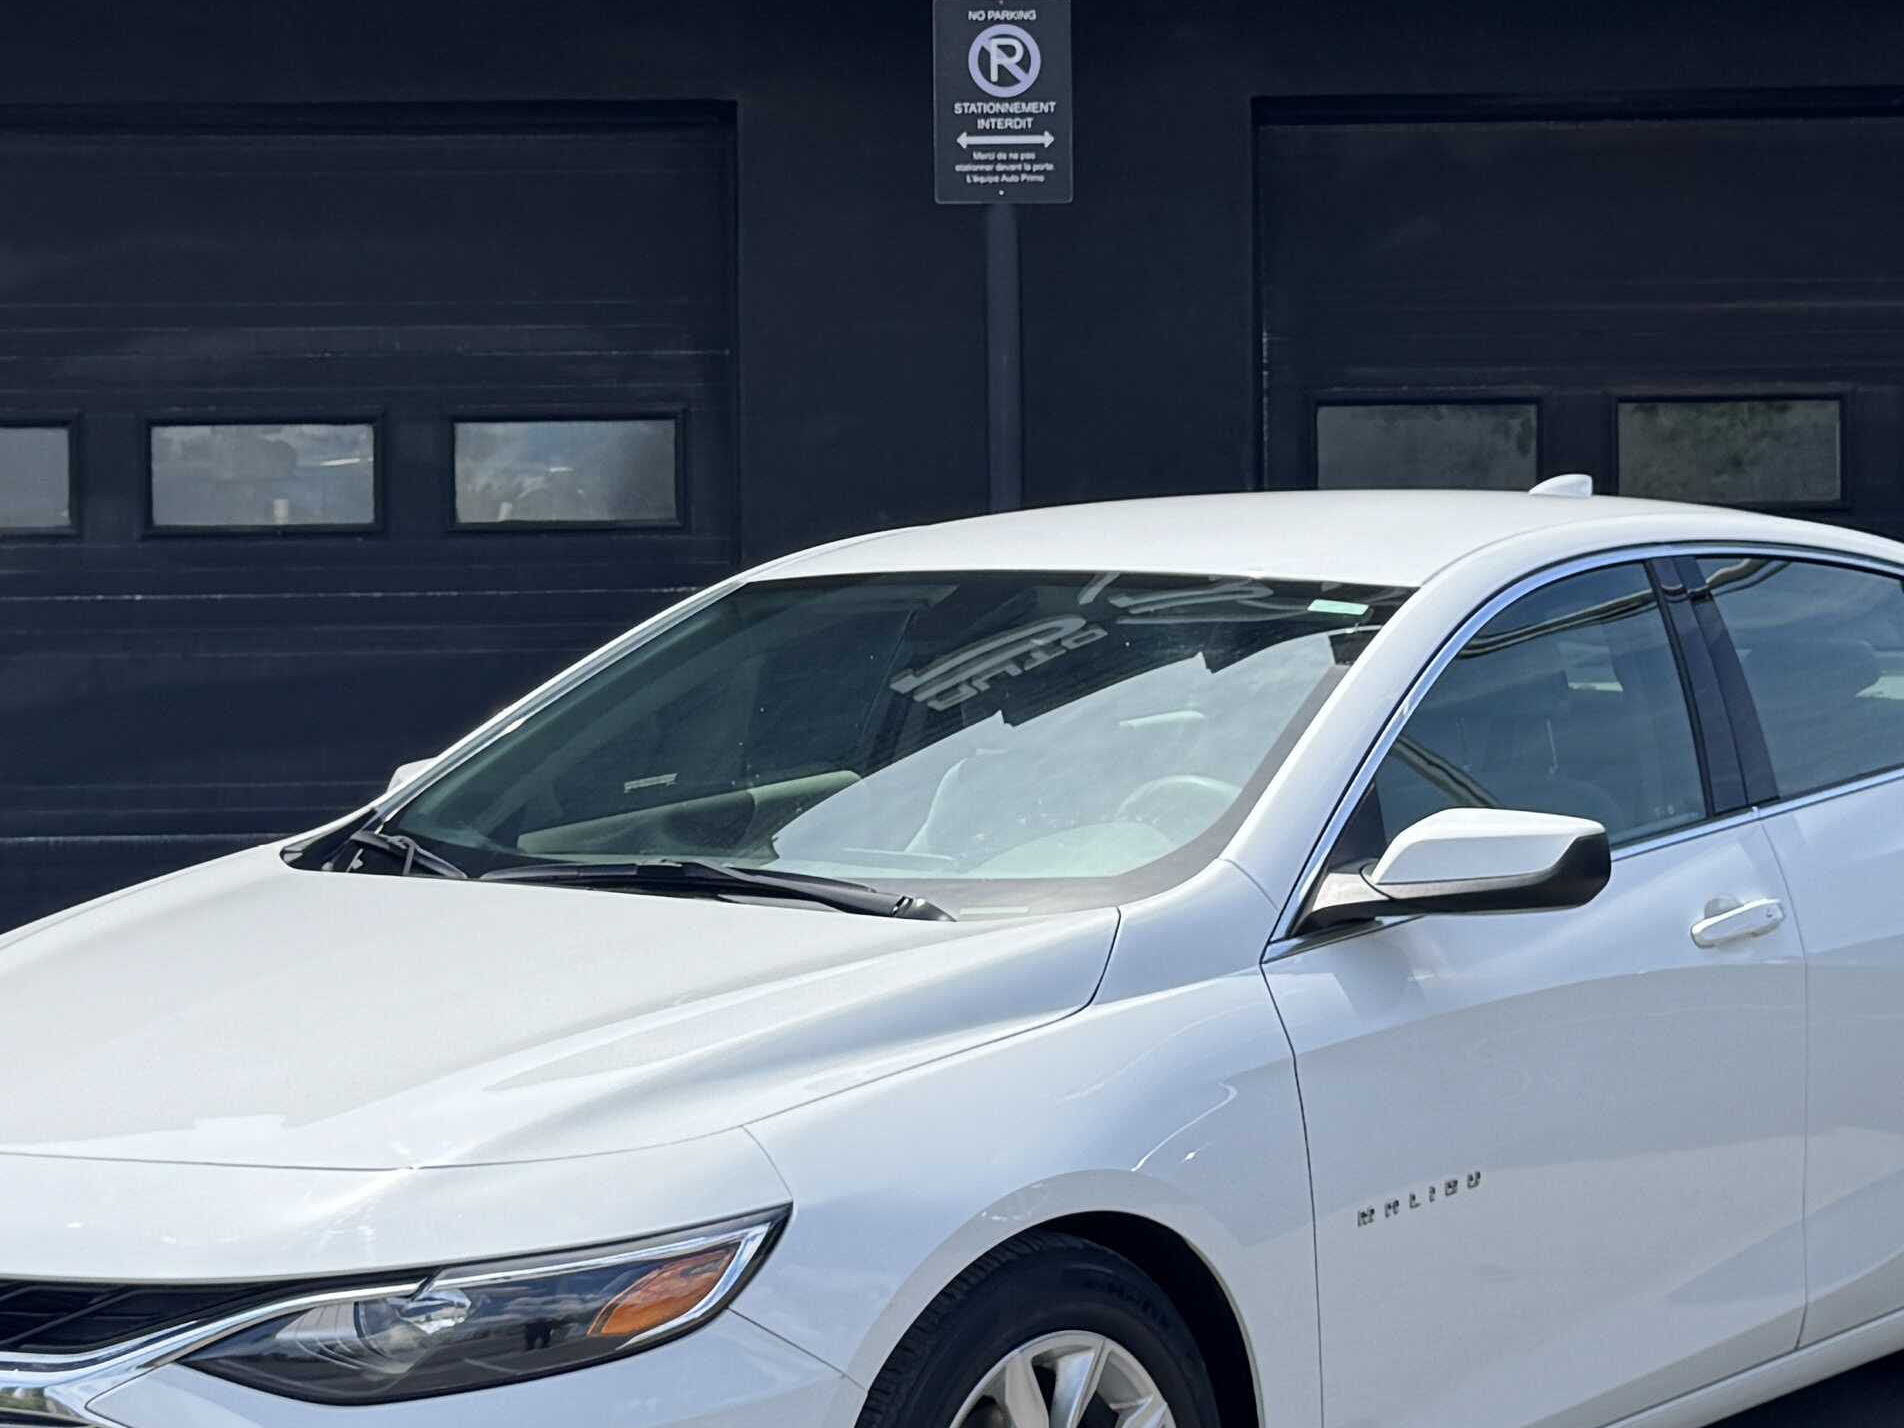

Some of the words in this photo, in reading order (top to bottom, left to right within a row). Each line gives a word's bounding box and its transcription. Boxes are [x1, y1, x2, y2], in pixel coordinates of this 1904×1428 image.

[968, 10, 986, 21] NO
[987, 9, 1037, 21] PARKING
[954, 101, 1056, 115] STATIONNEMENT
[976, 117, 1034, 130] INTERDIT
[1357, 1171, 1481, 1227] MALIBU
